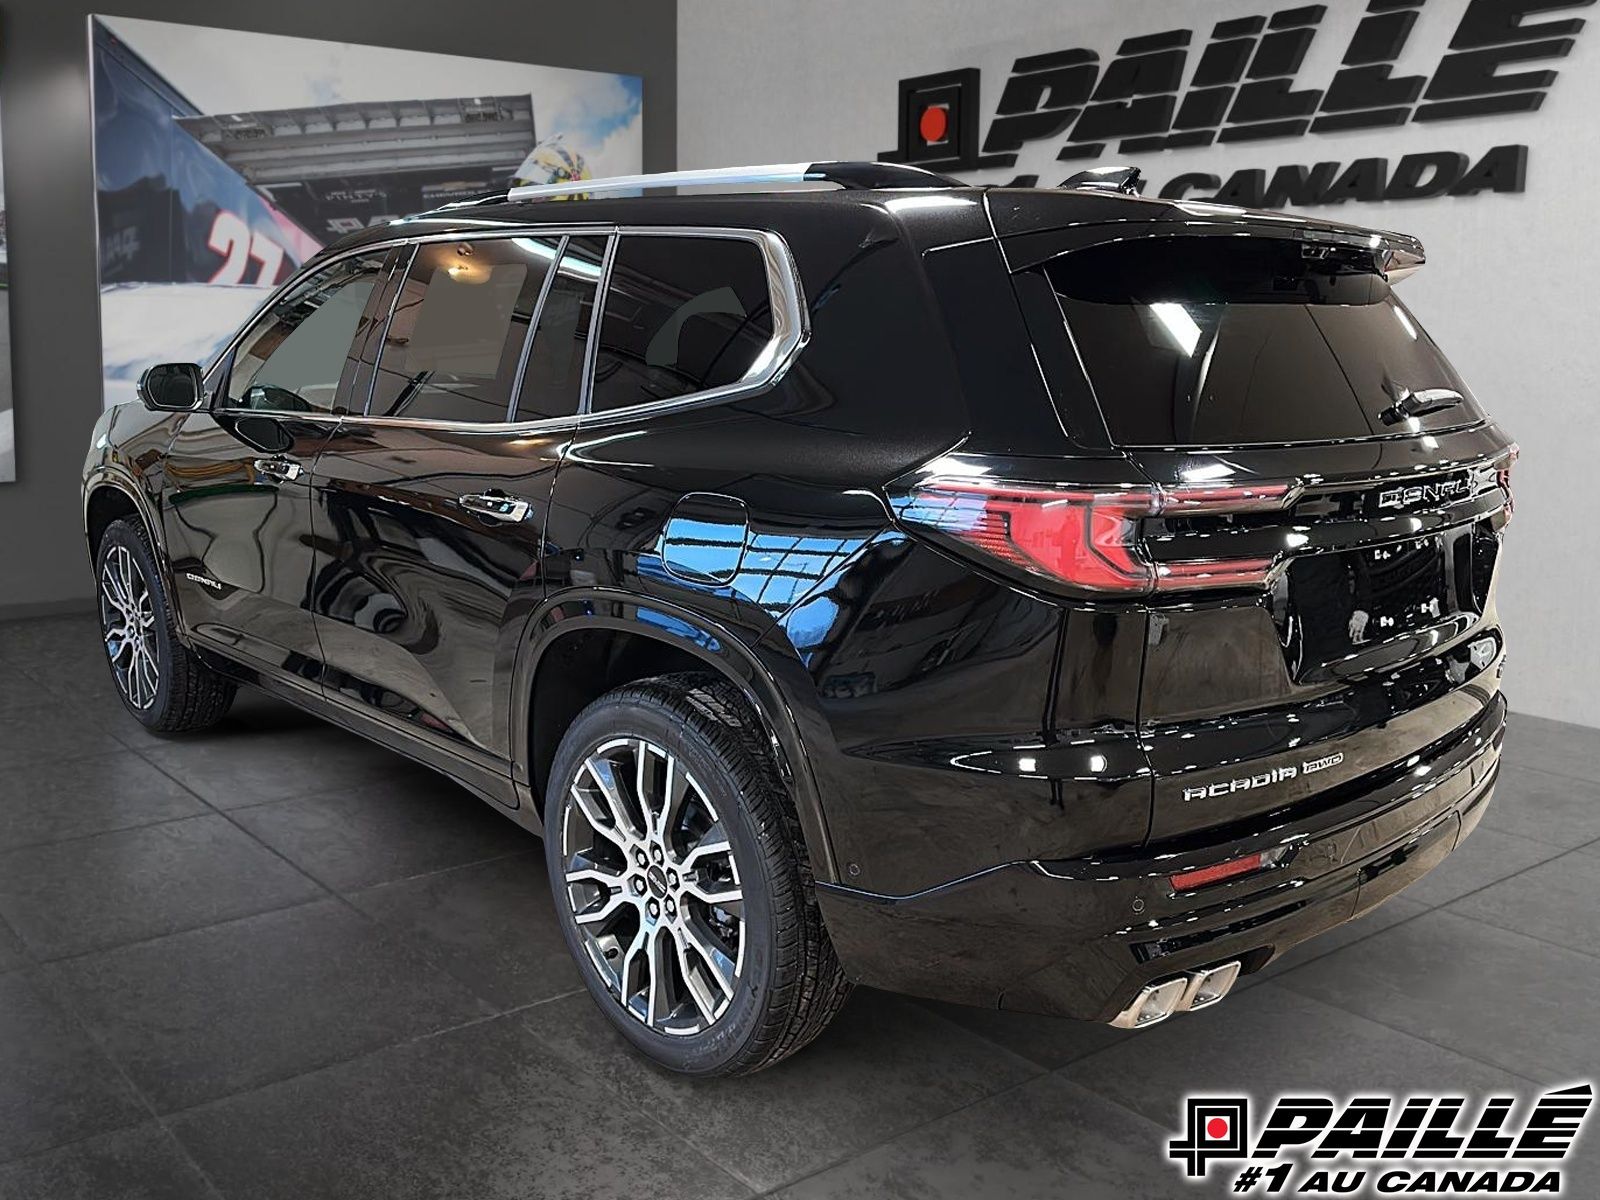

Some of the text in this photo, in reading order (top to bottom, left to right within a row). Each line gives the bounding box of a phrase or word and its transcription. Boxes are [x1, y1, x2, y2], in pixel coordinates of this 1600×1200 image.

[1160, 144, 1528, 208] CANADA
[207, 208, 285, 286] 27
[1182, 766, 1297, 802] ACADIA
